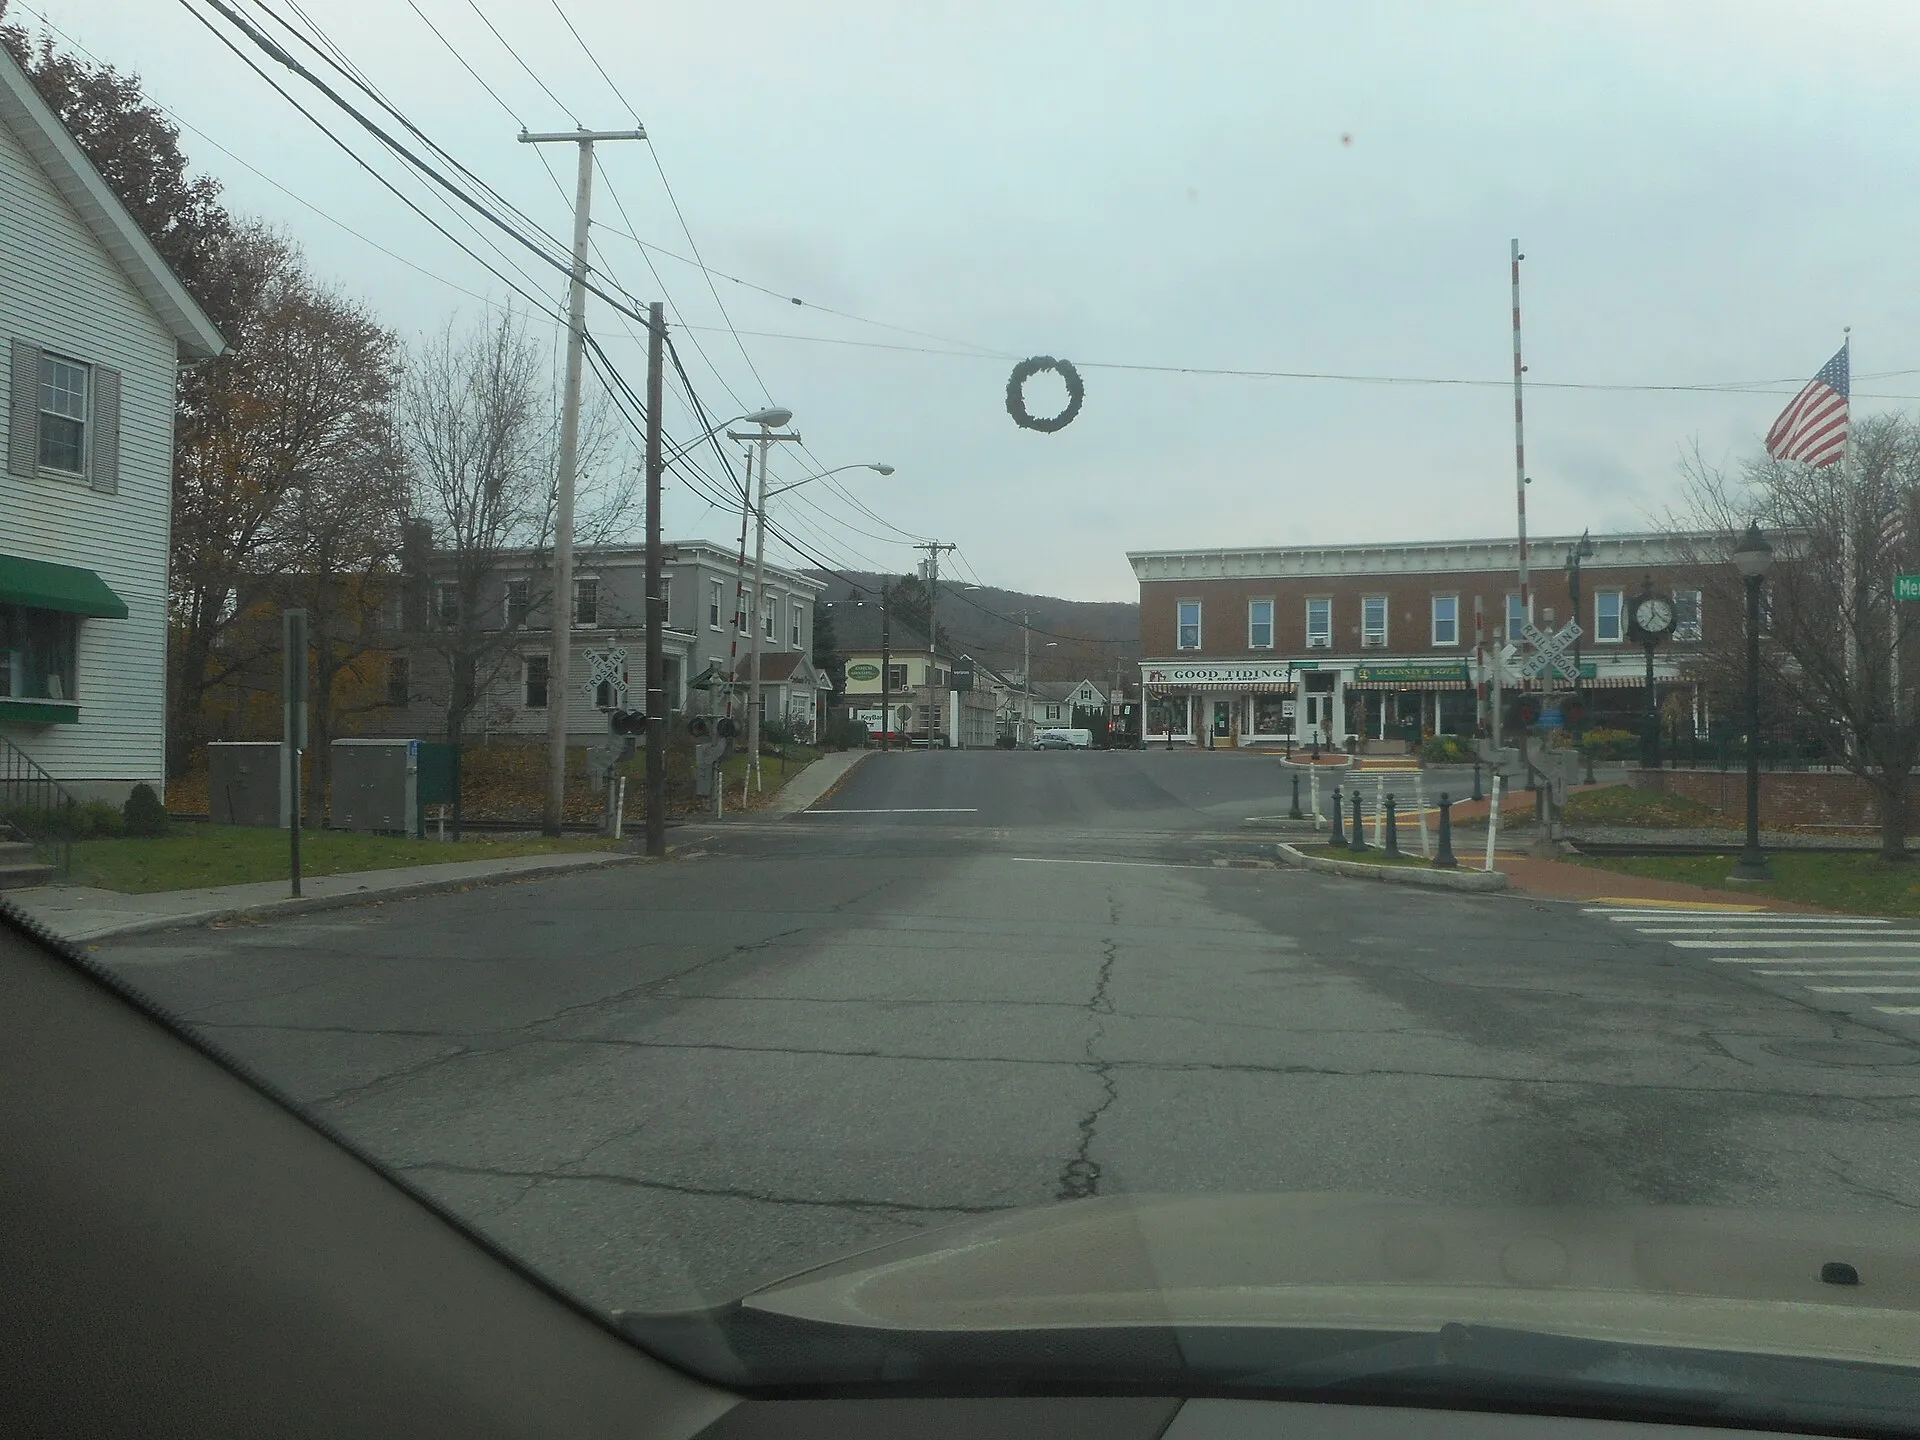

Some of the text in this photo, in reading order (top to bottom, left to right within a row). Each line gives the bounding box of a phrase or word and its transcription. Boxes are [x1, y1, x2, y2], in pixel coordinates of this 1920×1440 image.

[1900, 579, 1920, 596] Me
[584, 649, 626, 692] RAILROAD
[584, 649, 626, 693] CROSSING
[1521, 625, 1580, 677] CROSSING
[1523, 624, 1577, 679] RAILROAD
[1174, 669, 1291, 679] GOOD TIDINGS
[861, 714, 884, 722] KeyBan
